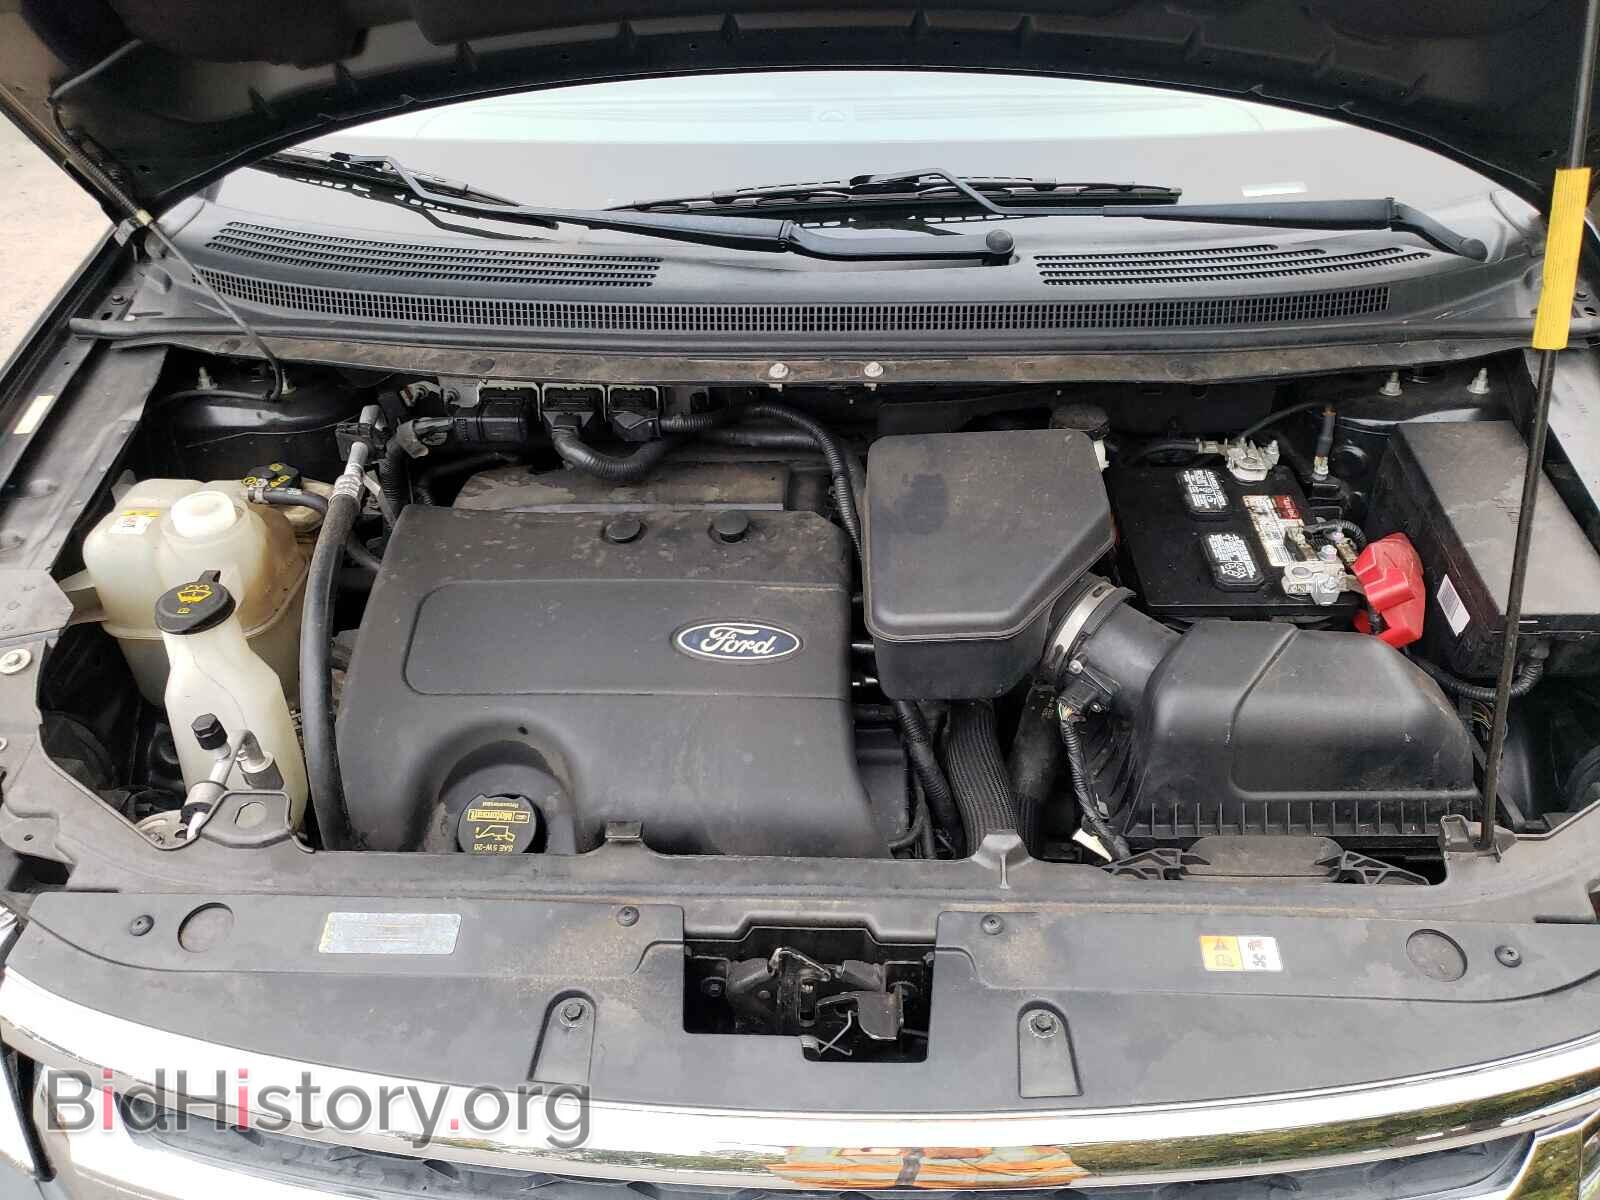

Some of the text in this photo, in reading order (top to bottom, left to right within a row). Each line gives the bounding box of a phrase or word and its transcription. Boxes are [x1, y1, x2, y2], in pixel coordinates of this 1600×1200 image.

[701, 626, 777, 654] Ford
[470, 810, 513, 821] Motorcraft
[474, 843, 498, 851] 5W-20
